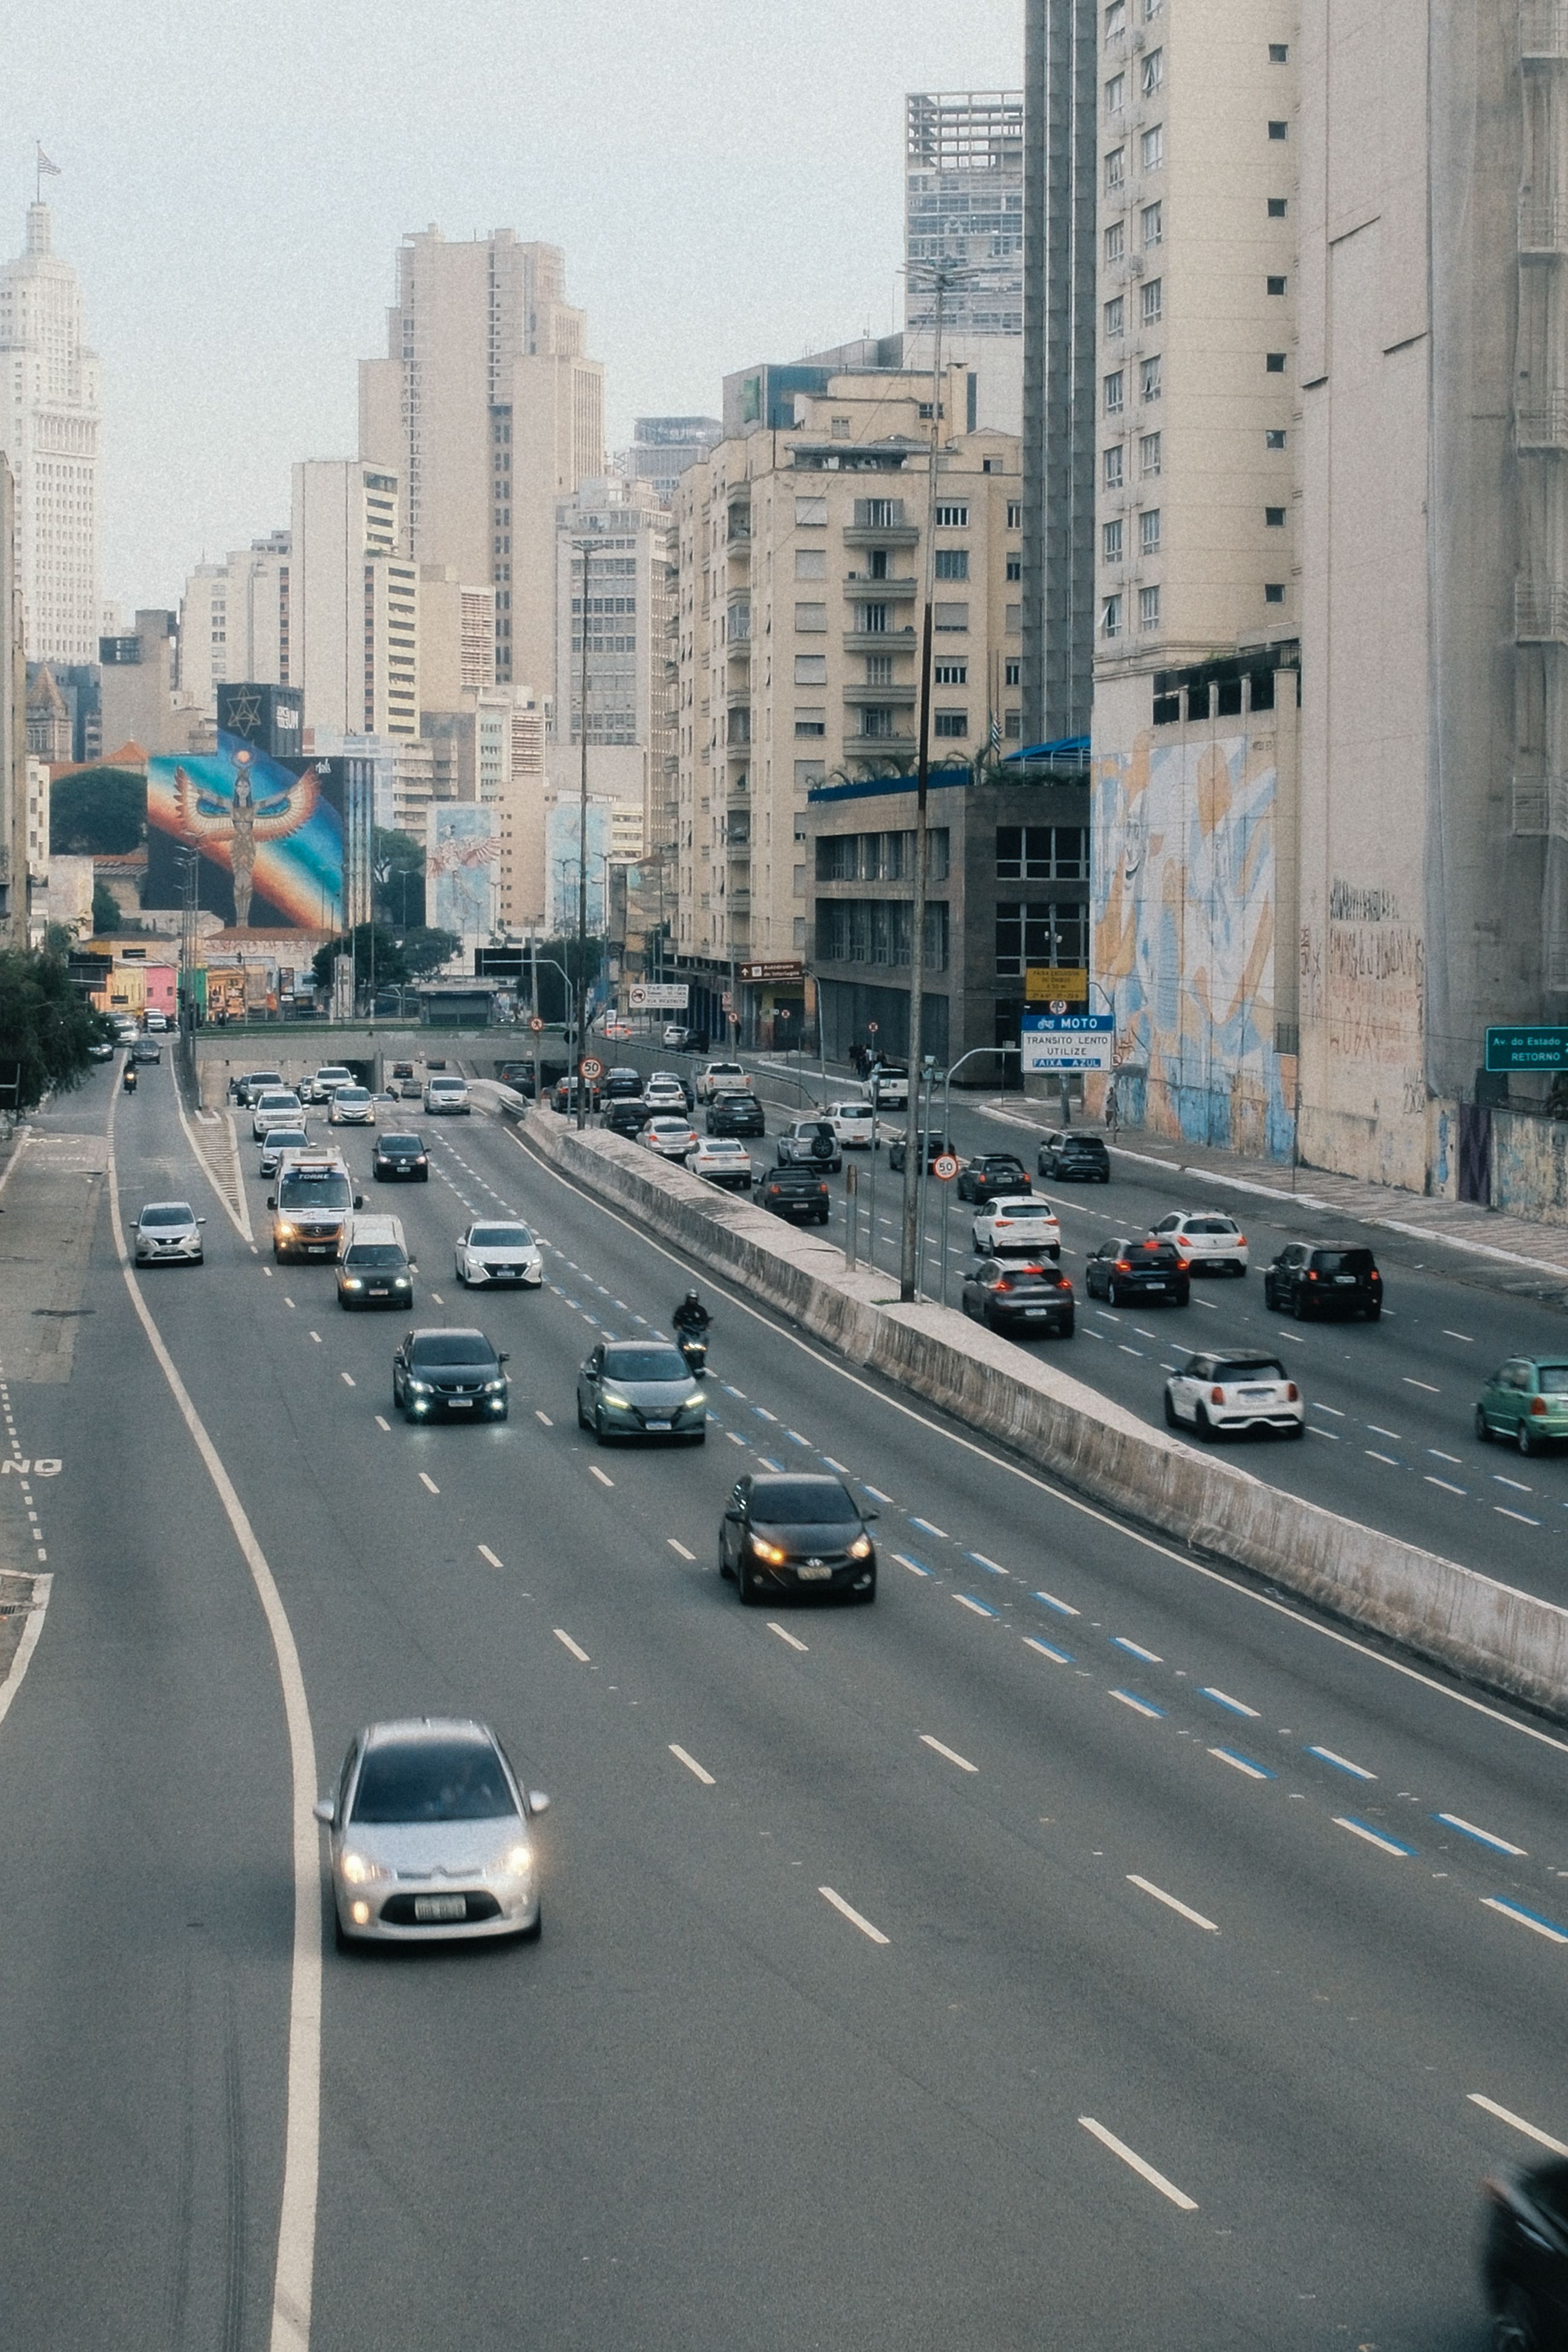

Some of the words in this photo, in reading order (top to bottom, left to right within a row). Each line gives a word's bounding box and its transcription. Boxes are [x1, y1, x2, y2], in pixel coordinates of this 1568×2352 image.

[1061, 1018, 1097, 1028] MOTO
[1527, 1037, 1561, 1045] Estado
[1512, 1053, 1561, 1061] RETORNO
[584, 1062, 599, 1072] 50
[939, 1162, 953, 1172] 50
